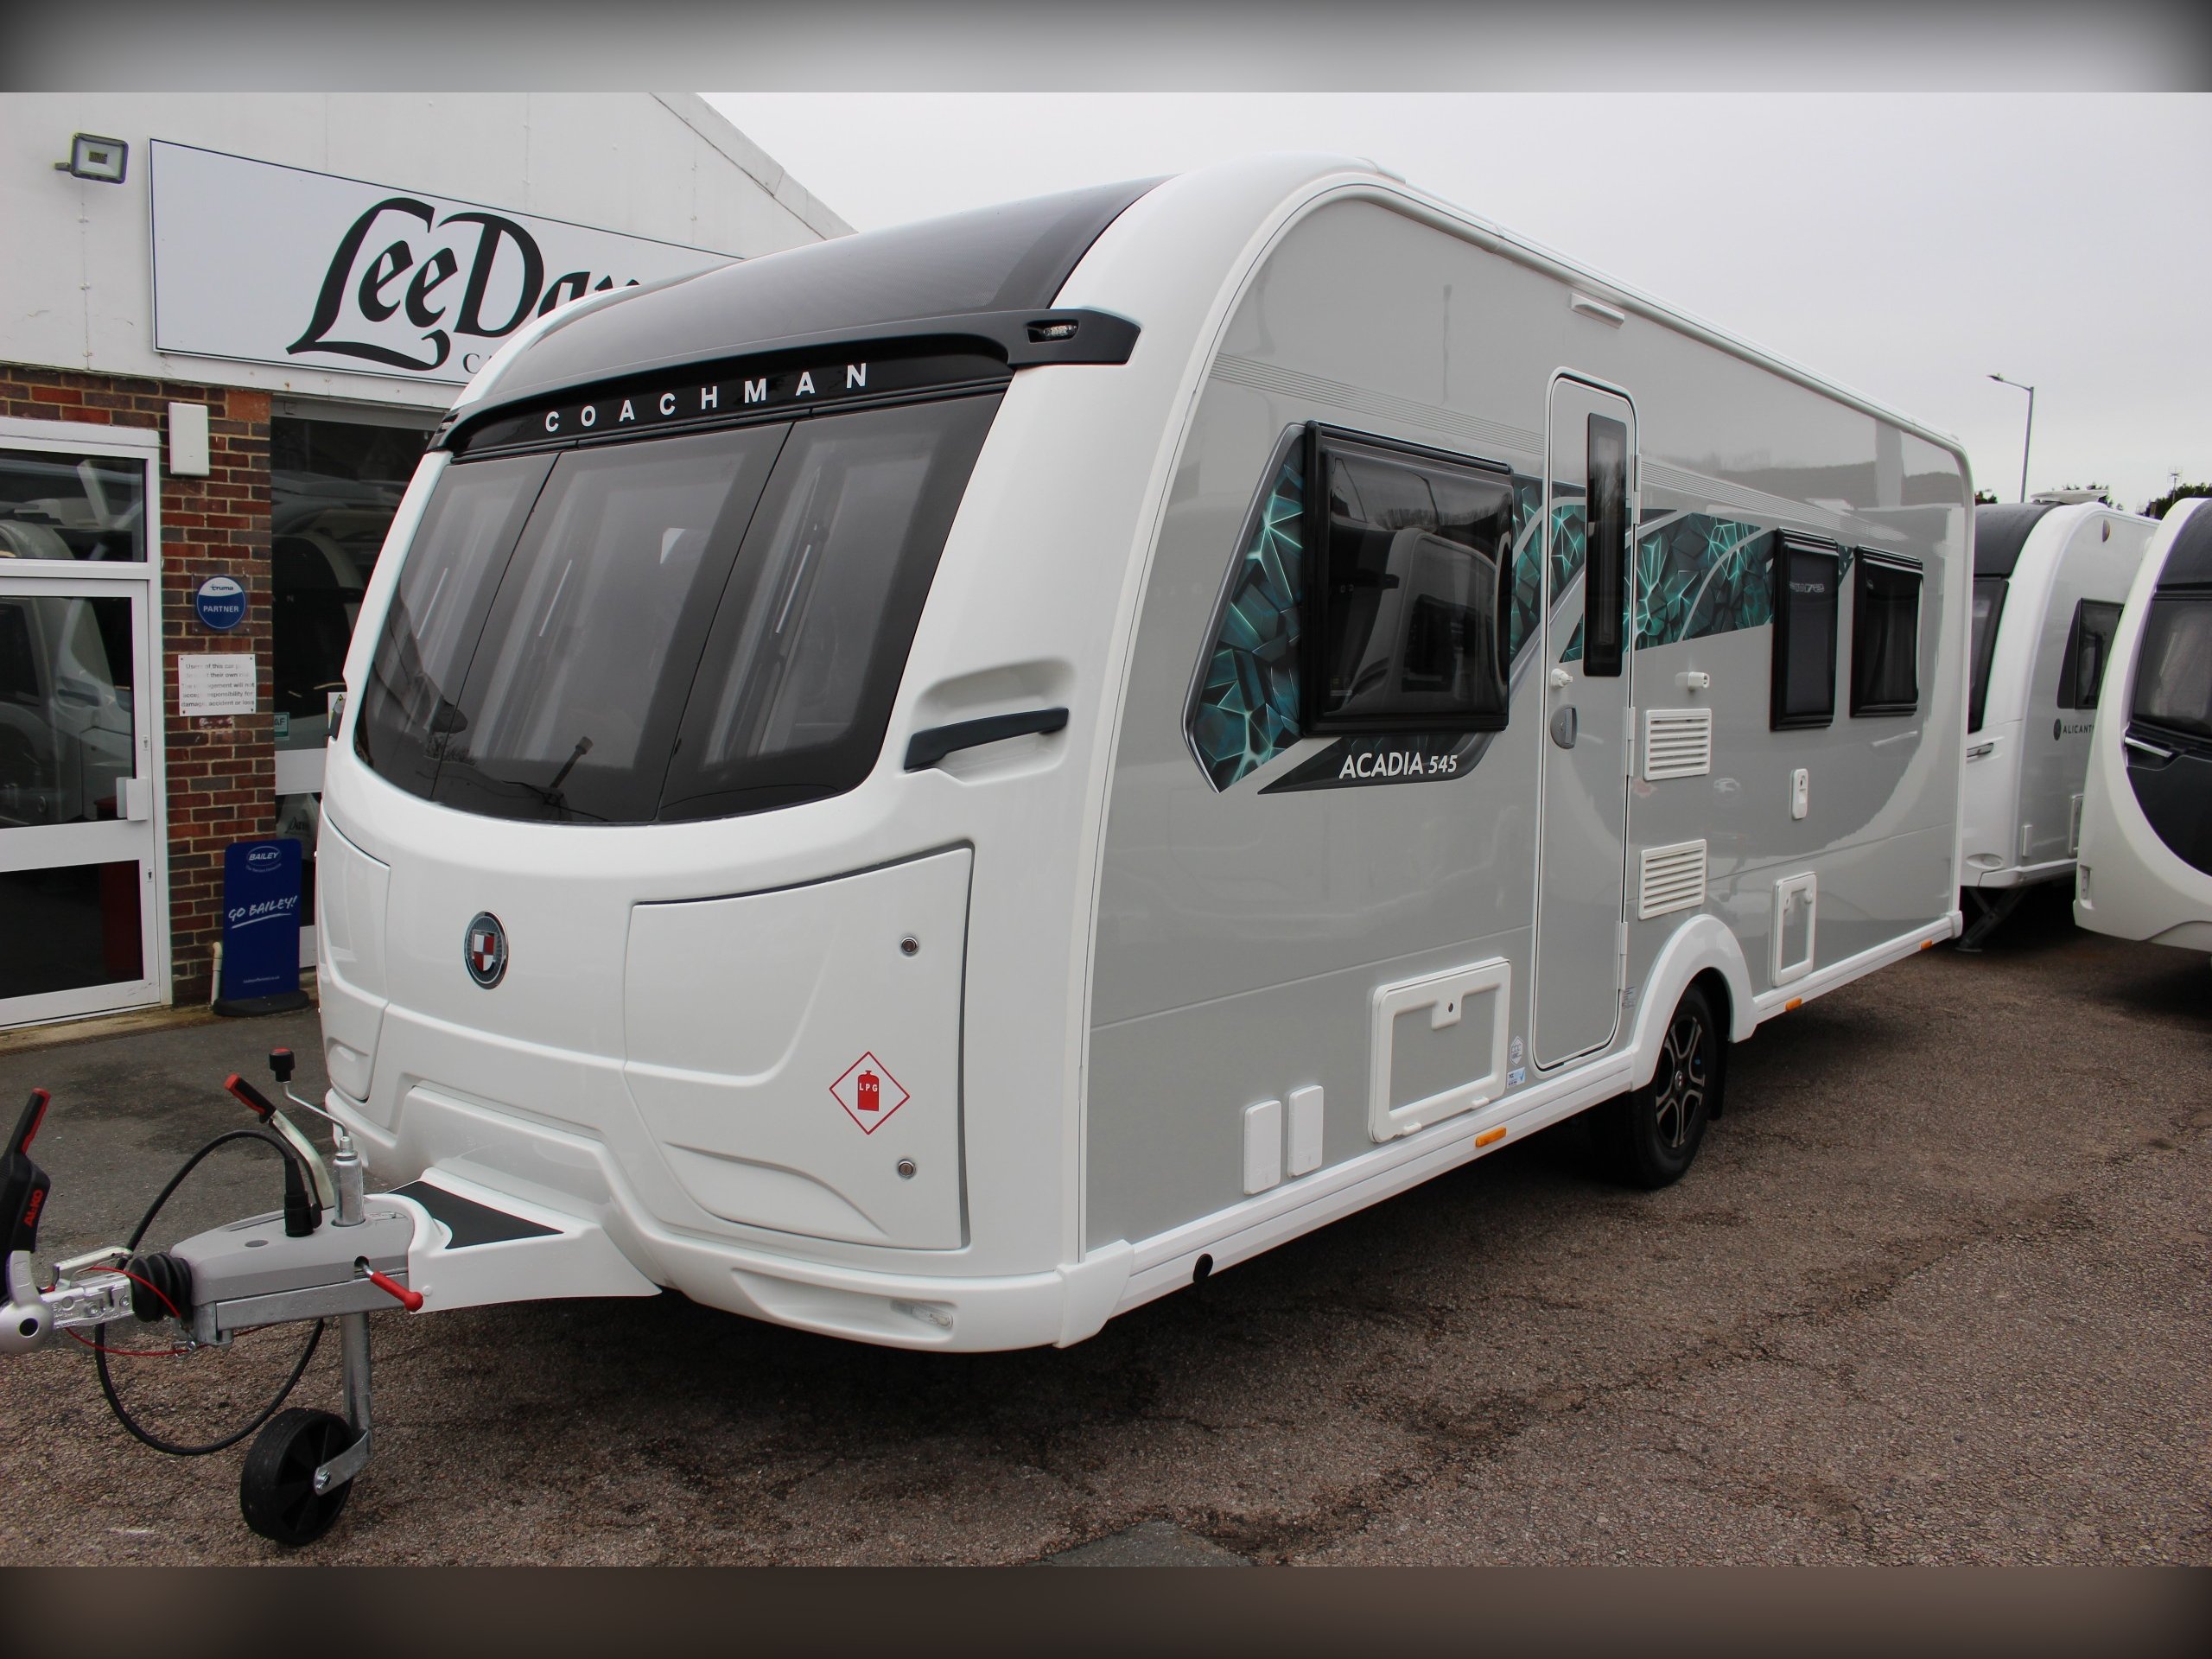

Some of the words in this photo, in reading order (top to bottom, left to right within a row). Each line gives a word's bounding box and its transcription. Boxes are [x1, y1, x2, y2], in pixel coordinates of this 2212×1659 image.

[286, 197, 458, 371] Lee
[544, 363, 867, 432] COACHMAN
[1339, 752, 1424, 779] ACADIA
[1428, 754, 1458, 774] 545
[249, 852, 278, 861] BAILEY
[228, 907, 245, 922] GO
[249, 895, 298, 916] BAILEY!
[859, 1083, 879, 1092] LPG
